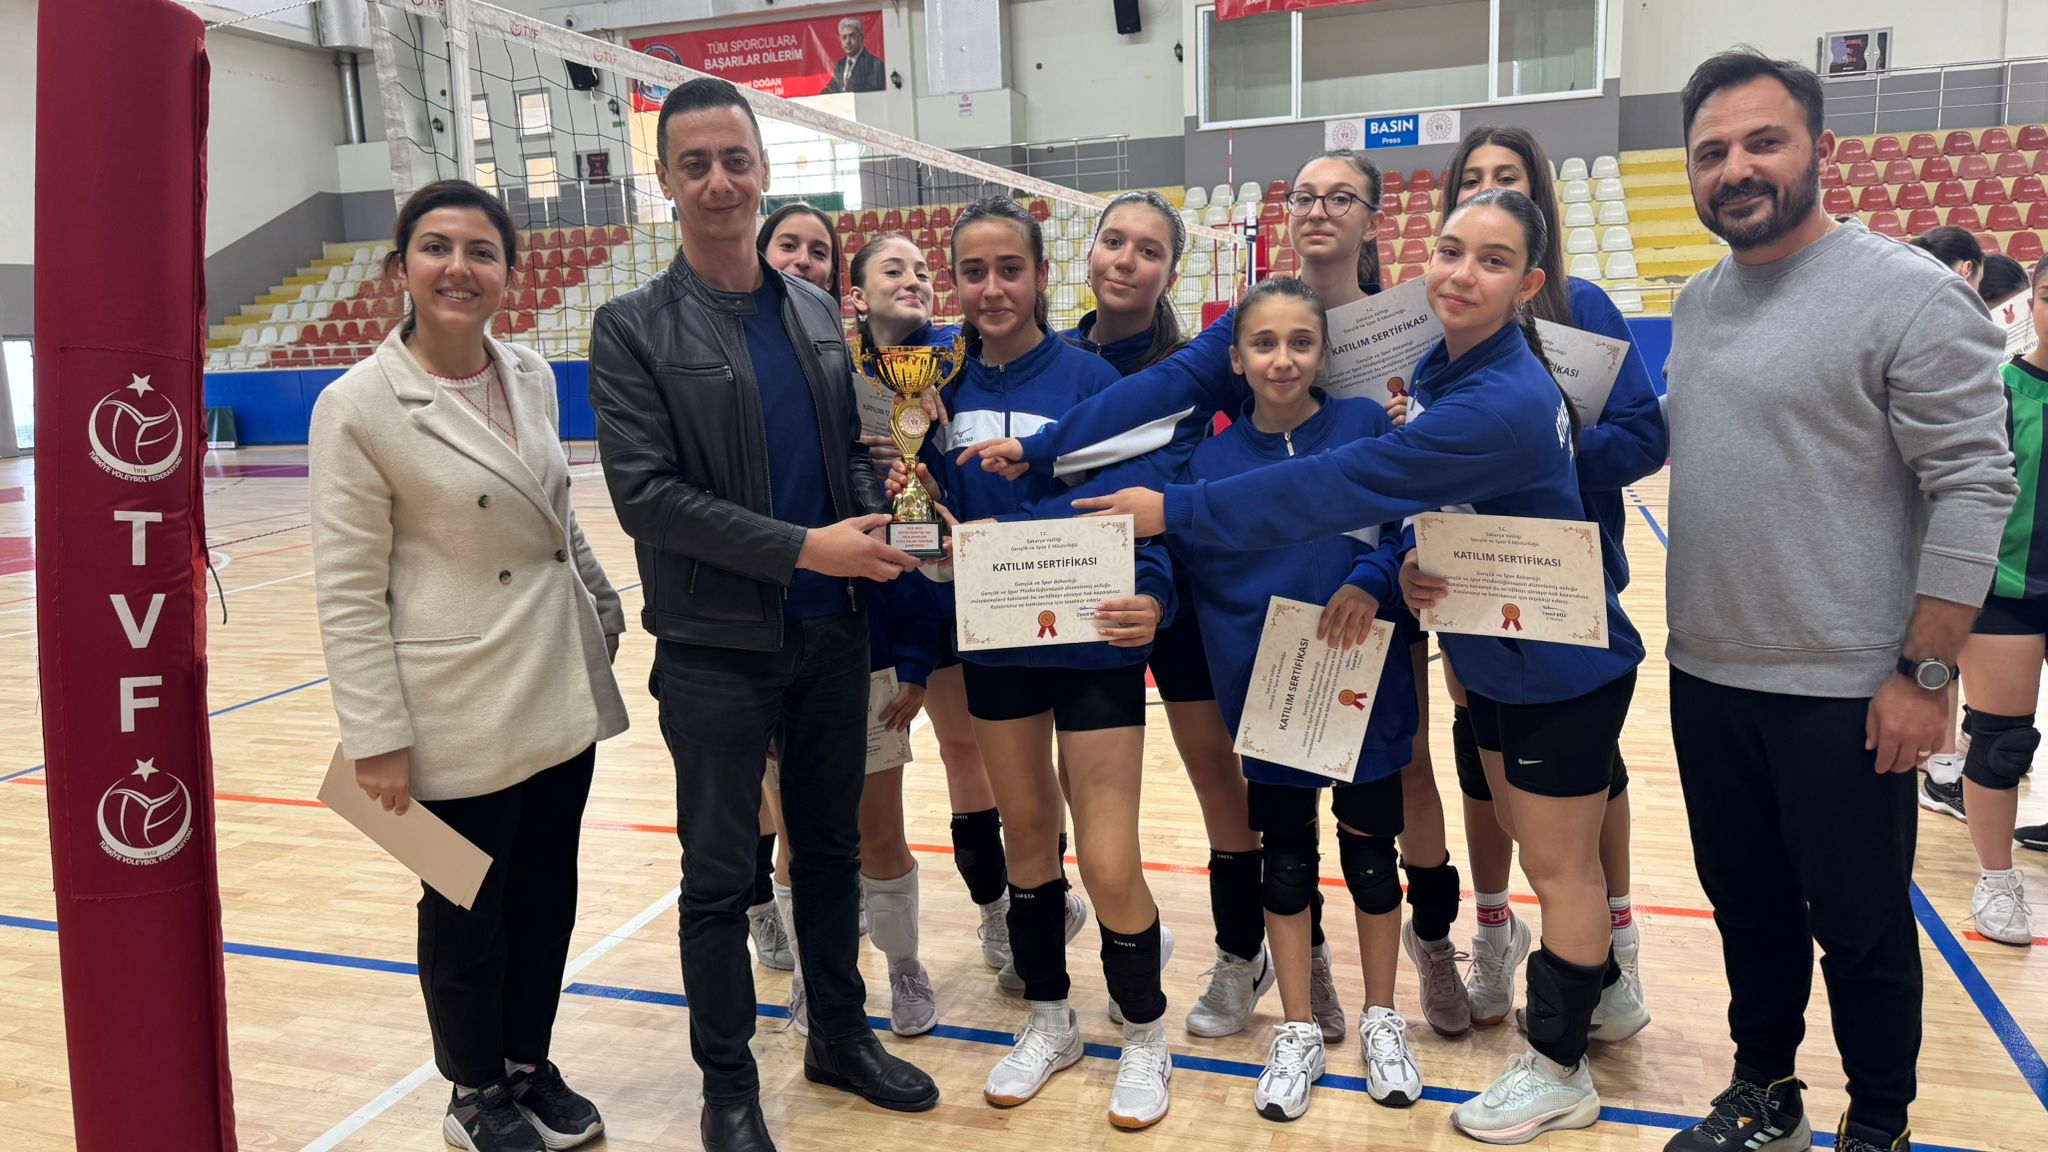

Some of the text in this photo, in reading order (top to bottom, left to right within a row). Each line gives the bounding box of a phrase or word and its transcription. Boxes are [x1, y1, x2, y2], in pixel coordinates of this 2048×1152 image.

[523, 25, 539, 39] TVF
[707, 35, 798, 55] TÜM SPORCULARA
[704, 48, 803, 71] BAŞARILAR DİLERİM
[753, 78, 782, 89] DOĞAN
[1370, 119, 1414, 134] BASIN
[1331, 336, 1369, 357] KATILIM
[1371, 314, 1428, 343] SERTİFİKASI
[88, 450, 183, 483] TÜRKİYE VOLEYBOL FEDERASYONU
[992, 556, 1097, 572] KATILIM SERTİFİKASI
[1453, 550, 1561, 567] KATILIM SERTİFİKASI
[1277, 637, 1309, 730] KATILIM SERTİFİKASI
[99, 827, 194, 866] TÜRKİYE VOLEYBOL FEDERASYONU
